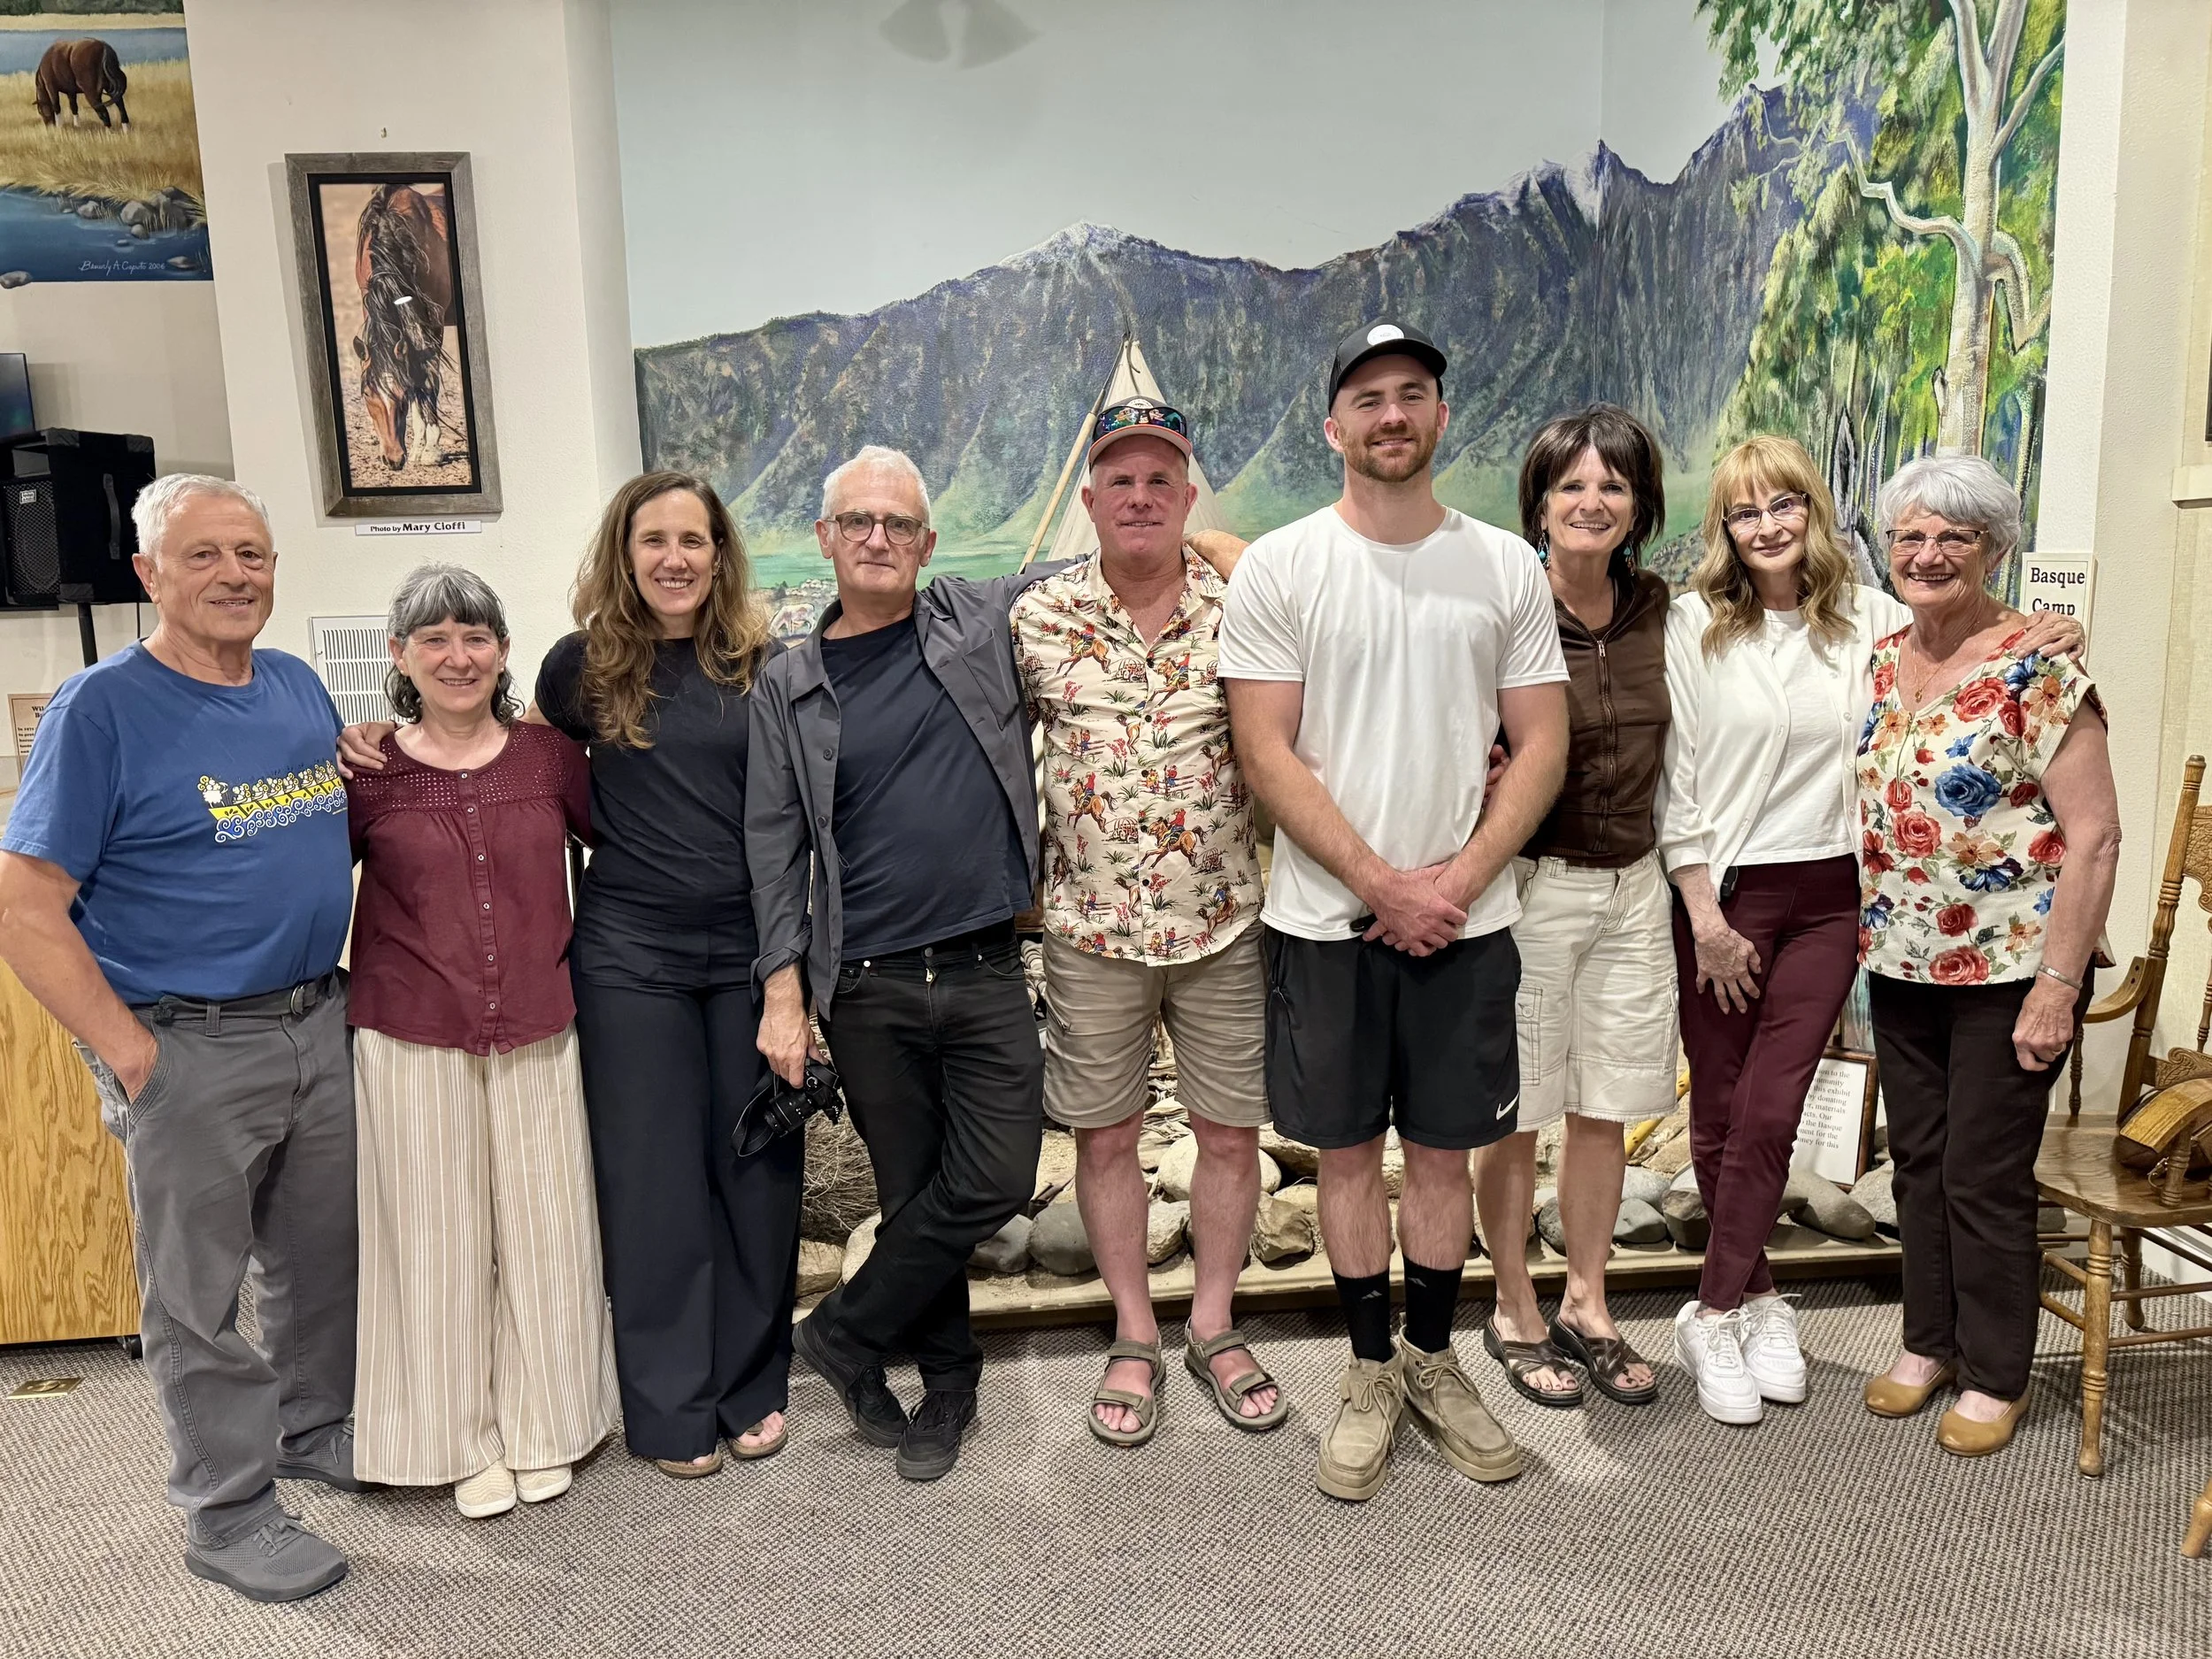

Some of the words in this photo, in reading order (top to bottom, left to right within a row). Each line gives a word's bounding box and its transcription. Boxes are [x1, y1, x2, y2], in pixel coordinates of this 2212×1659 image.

[113, 259, 120, 270] A
[403, 523, 431, 533] Mary
[2030, 567, 2085, 588] Basque
[1827, 1087, 1850, 1097] exhibit
[1817, 1094, 1847, 1106] donating
[1815, 1104, 1846, 1114] materials
[1819, 1112, 1832, 1121] Our
[1817, 1121, 1842, 1132] Basque
